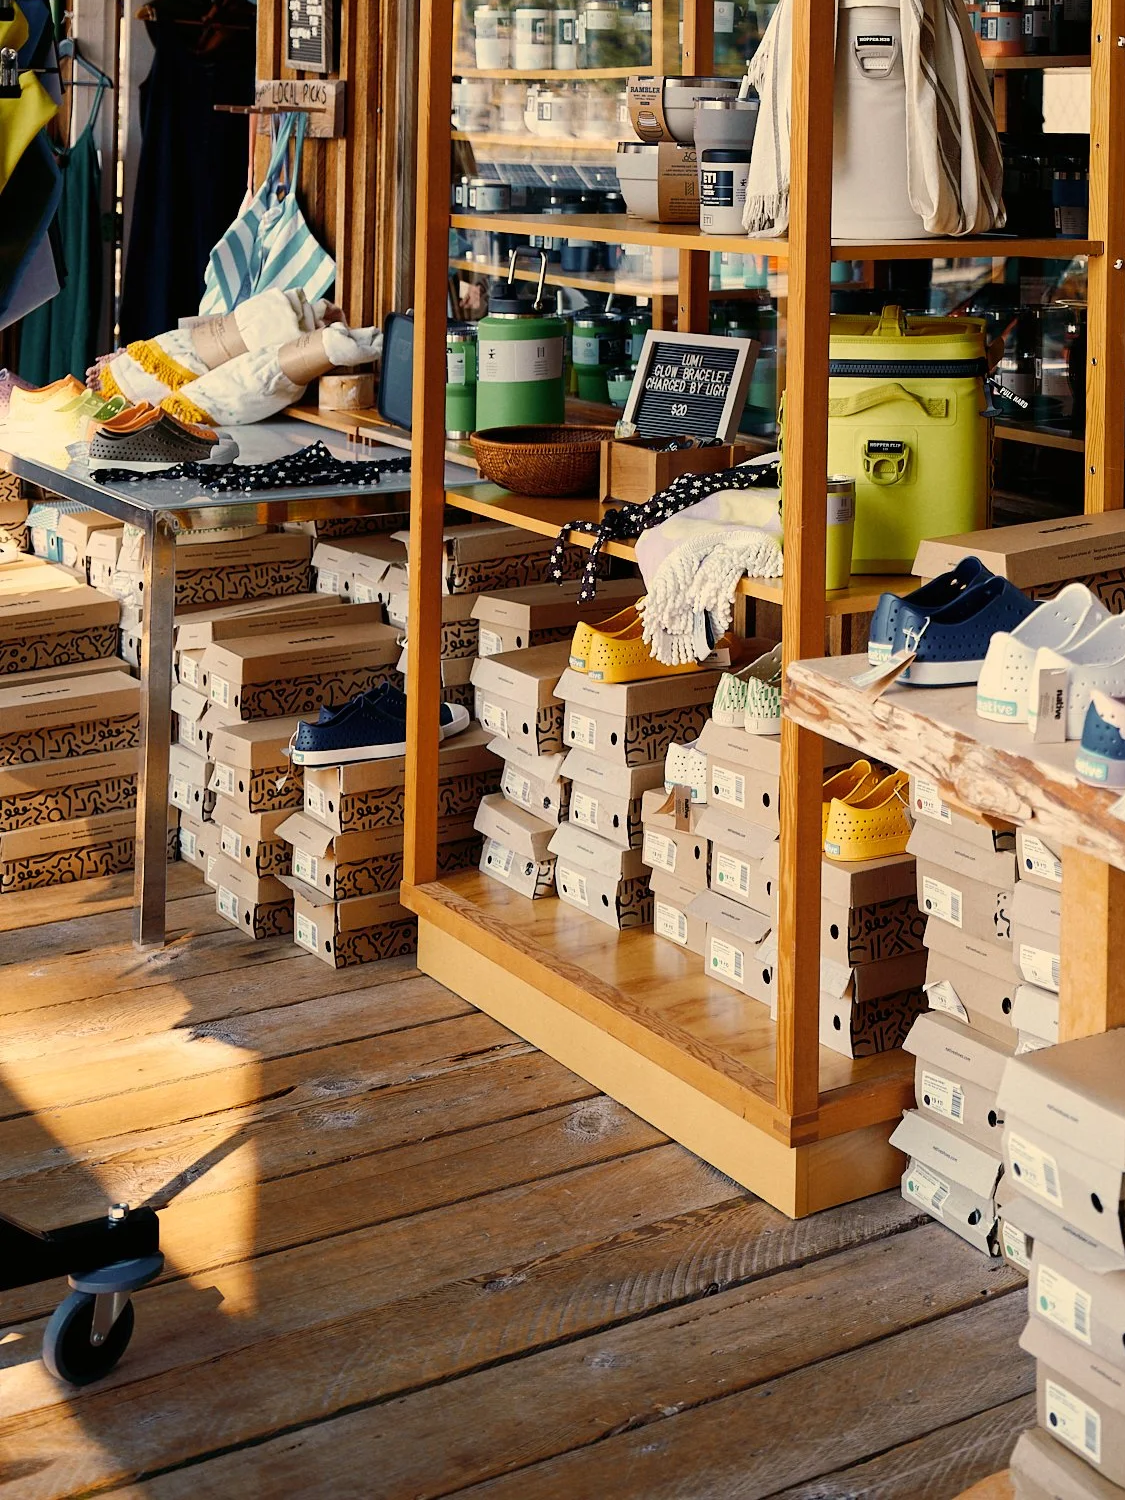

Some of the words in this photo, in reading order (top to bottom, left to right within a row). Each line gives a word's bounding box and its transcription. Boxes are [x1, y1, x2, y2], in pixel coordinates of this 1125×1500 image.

[272, 82, 299, 106] LOCAL
[302, 83, 327, 105] PICKS
[630, 86, 661, 94] RAMBLER
[703, 172, 717, 184] ETI
[681, 354, 703, 367] LUMI
[654, 364, 679, 378] GLOW
[682, 367, 730, 383] BRACELET
[645, 377, 686, 393] CHARGED
[689, 381, 703, 394] BY
[706, 384, 730, 397] LIGH
[999, 386, 1014, 401] PULL
[1013, 395, 1029, 410] HARD
[670, 403, 688, 417] $20
[1054, 689, 1064, 720] native
